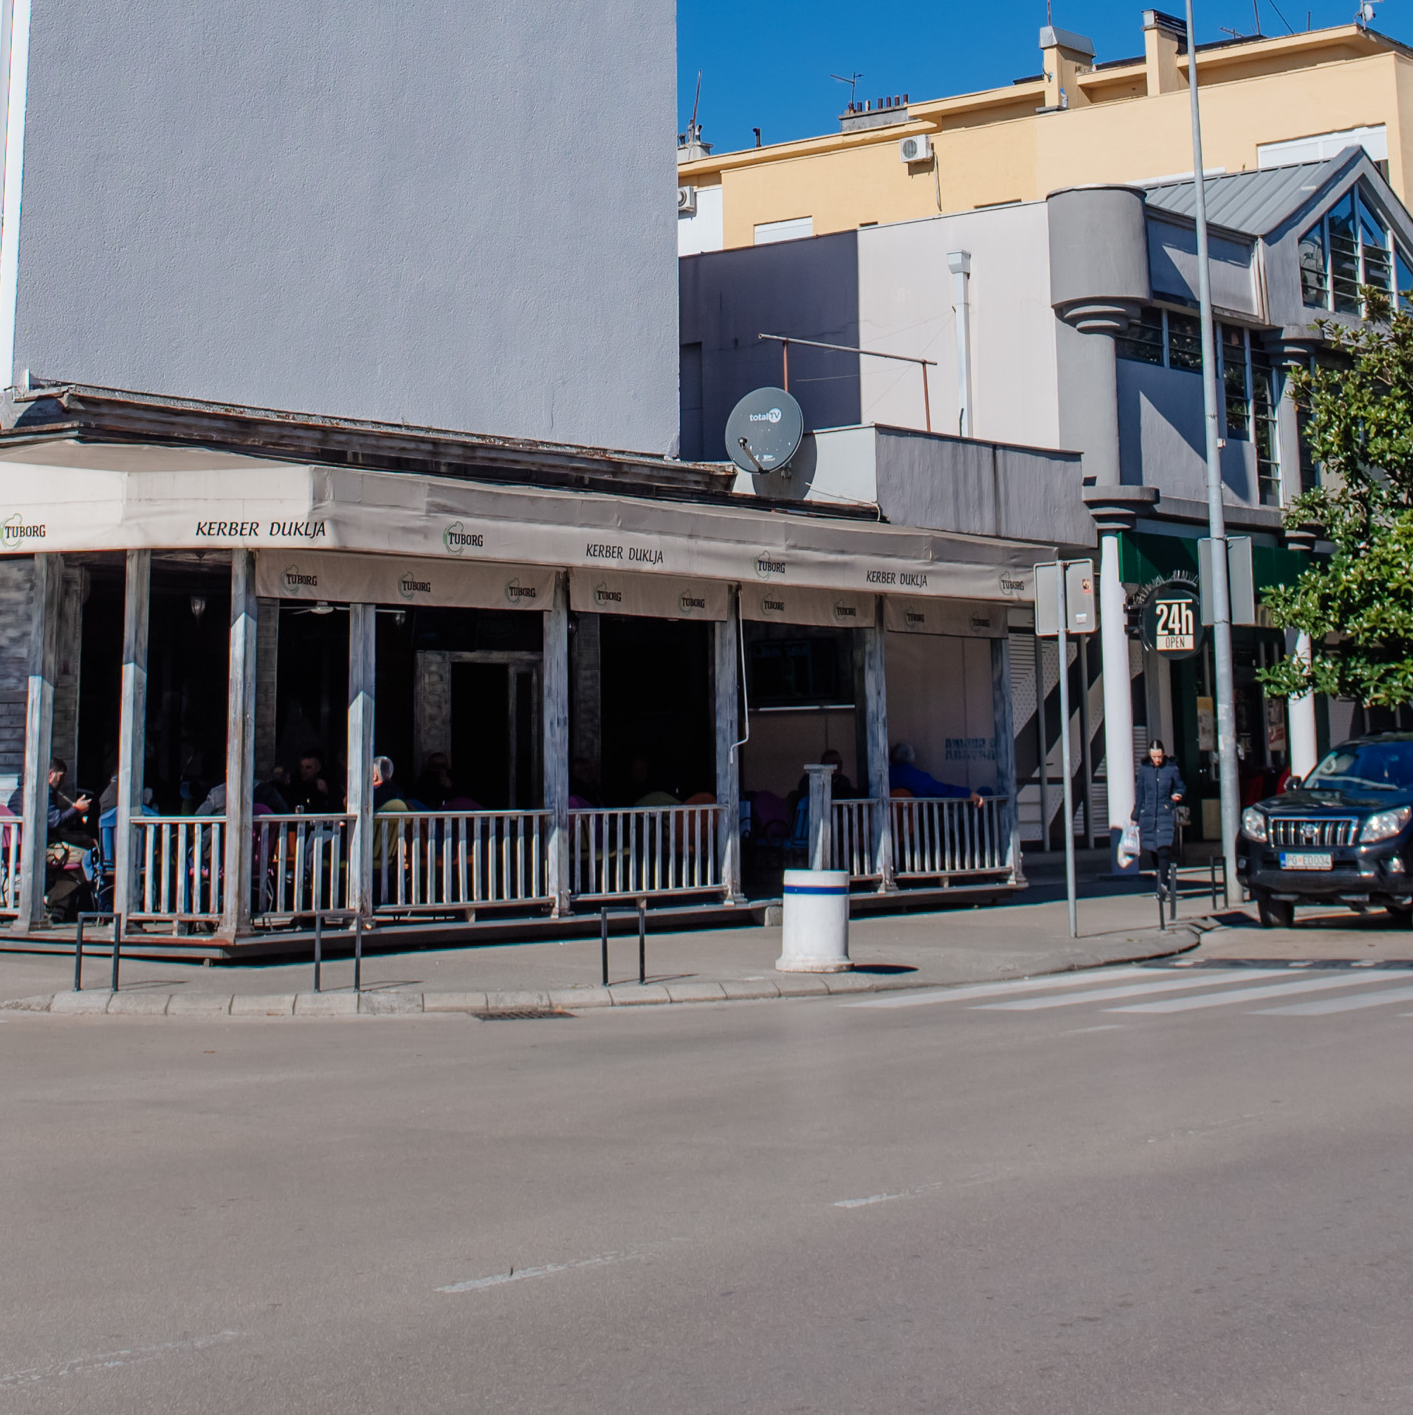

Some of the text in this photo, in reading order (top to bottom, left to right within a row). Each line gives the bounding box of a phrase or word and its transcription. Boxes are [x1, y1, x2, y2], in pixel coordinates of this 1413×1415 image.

[4, 524, 47, 539] TUBORG
[195, 520, 327, 539] KERBER DUKLJA
[448, 531, 484, 547] TUBORG
[585, 542, 665, 565] KERBER DUKLJA
[757, 559, 786, 574] TUBORG
[286, 573, 318, 586] TUBORG
[866, 570, 928, 588] KERBER DUKLJA
[1001, 579, 1025, 591] TUBORG
[402, 580, 431, 593] TUBORG
[508, 586, 536, 598] TUBORG
[597, 590, 622, 602] TUBORG
[682, 597, 706, 609] TUBORG
[764, 600, 785, 612] TUBORG
[837, 606, 857, 617] TUBORG
[1155, 602, 1194, 636] 24h
[1165, 636, 1186, 649] OPEN
